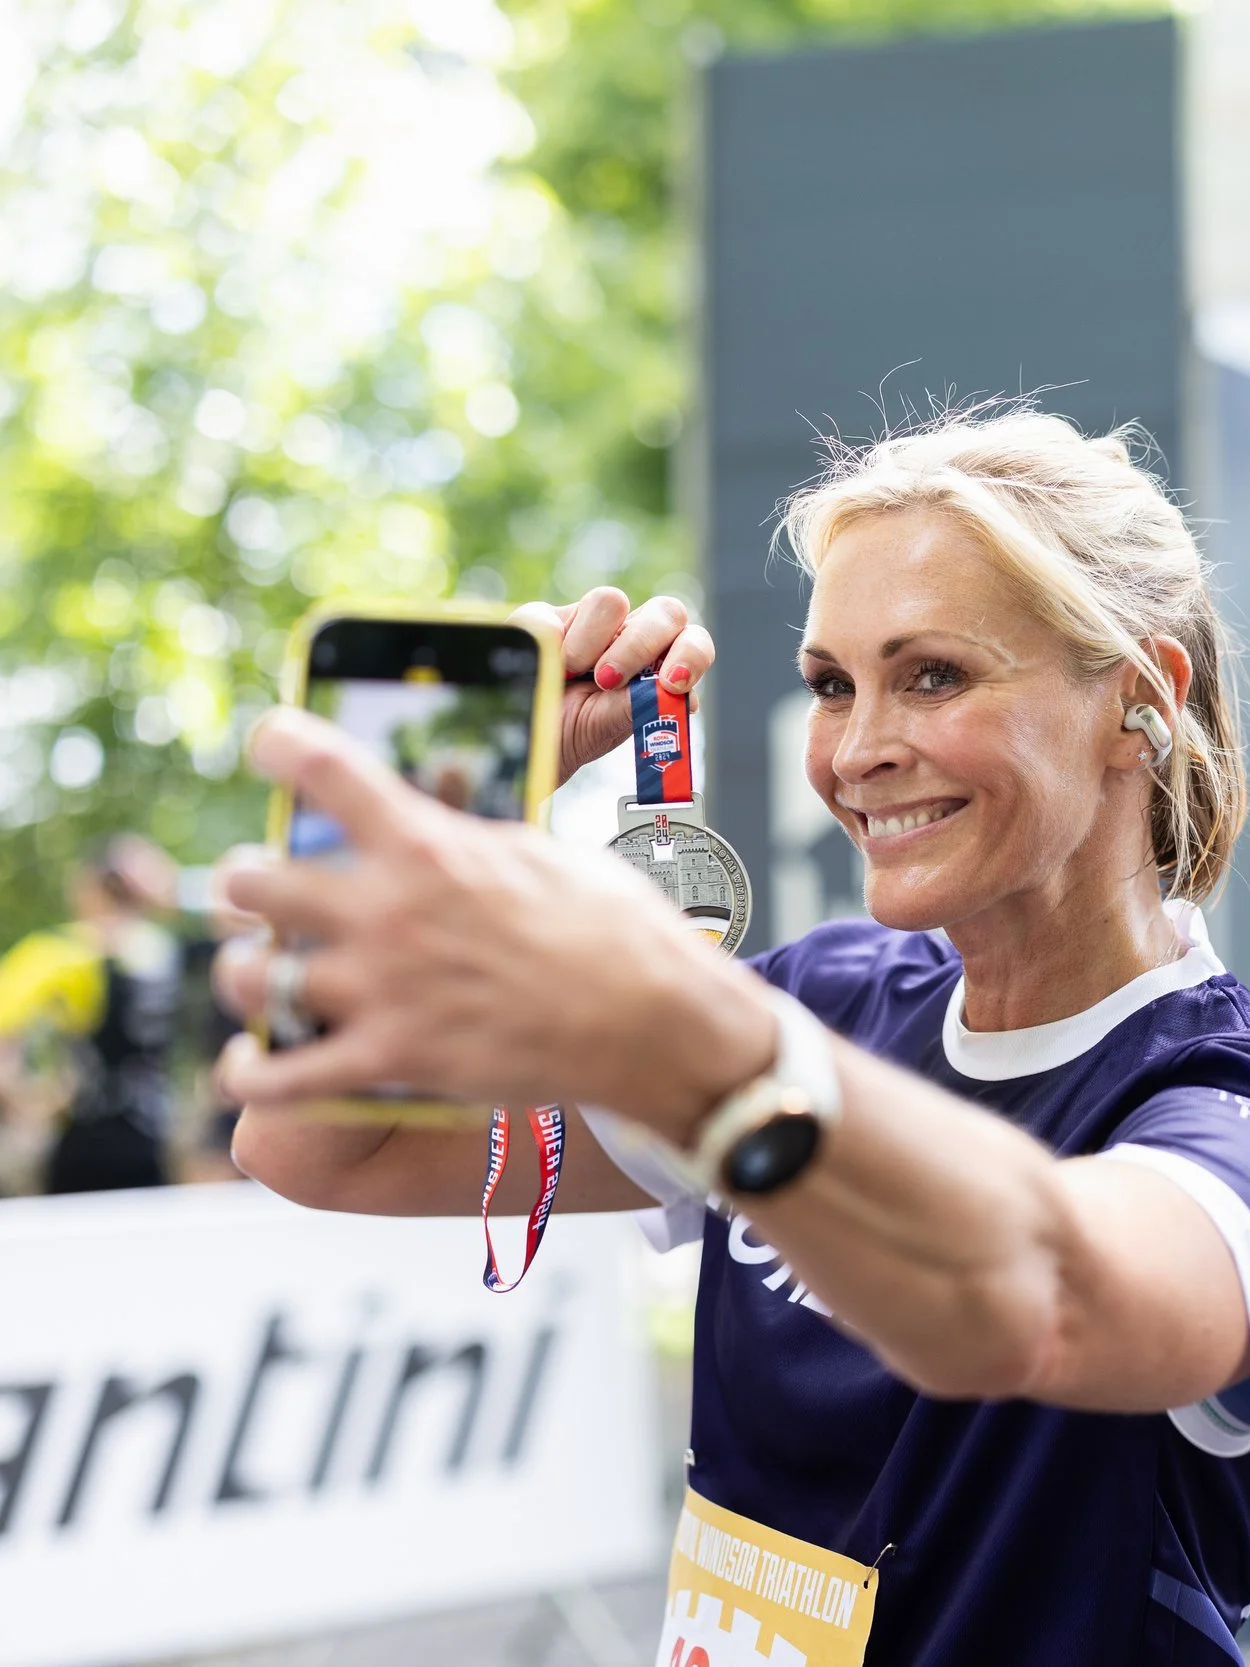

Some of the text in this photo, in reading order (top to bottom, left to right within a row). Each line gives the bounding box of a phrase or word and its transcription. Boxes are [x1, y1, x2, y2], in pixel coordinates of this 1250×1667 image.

[649, 739, 674, 748] WINDSOR
[656, 829, 668, 843] 24
[714, 844, 737, 874] ROYAL
[733, 873, 745, 921] WINDSOR
[697, 1521, 760, 1592] WINDSOR
[755, 1550, 858, 1629] TRIATHLON
